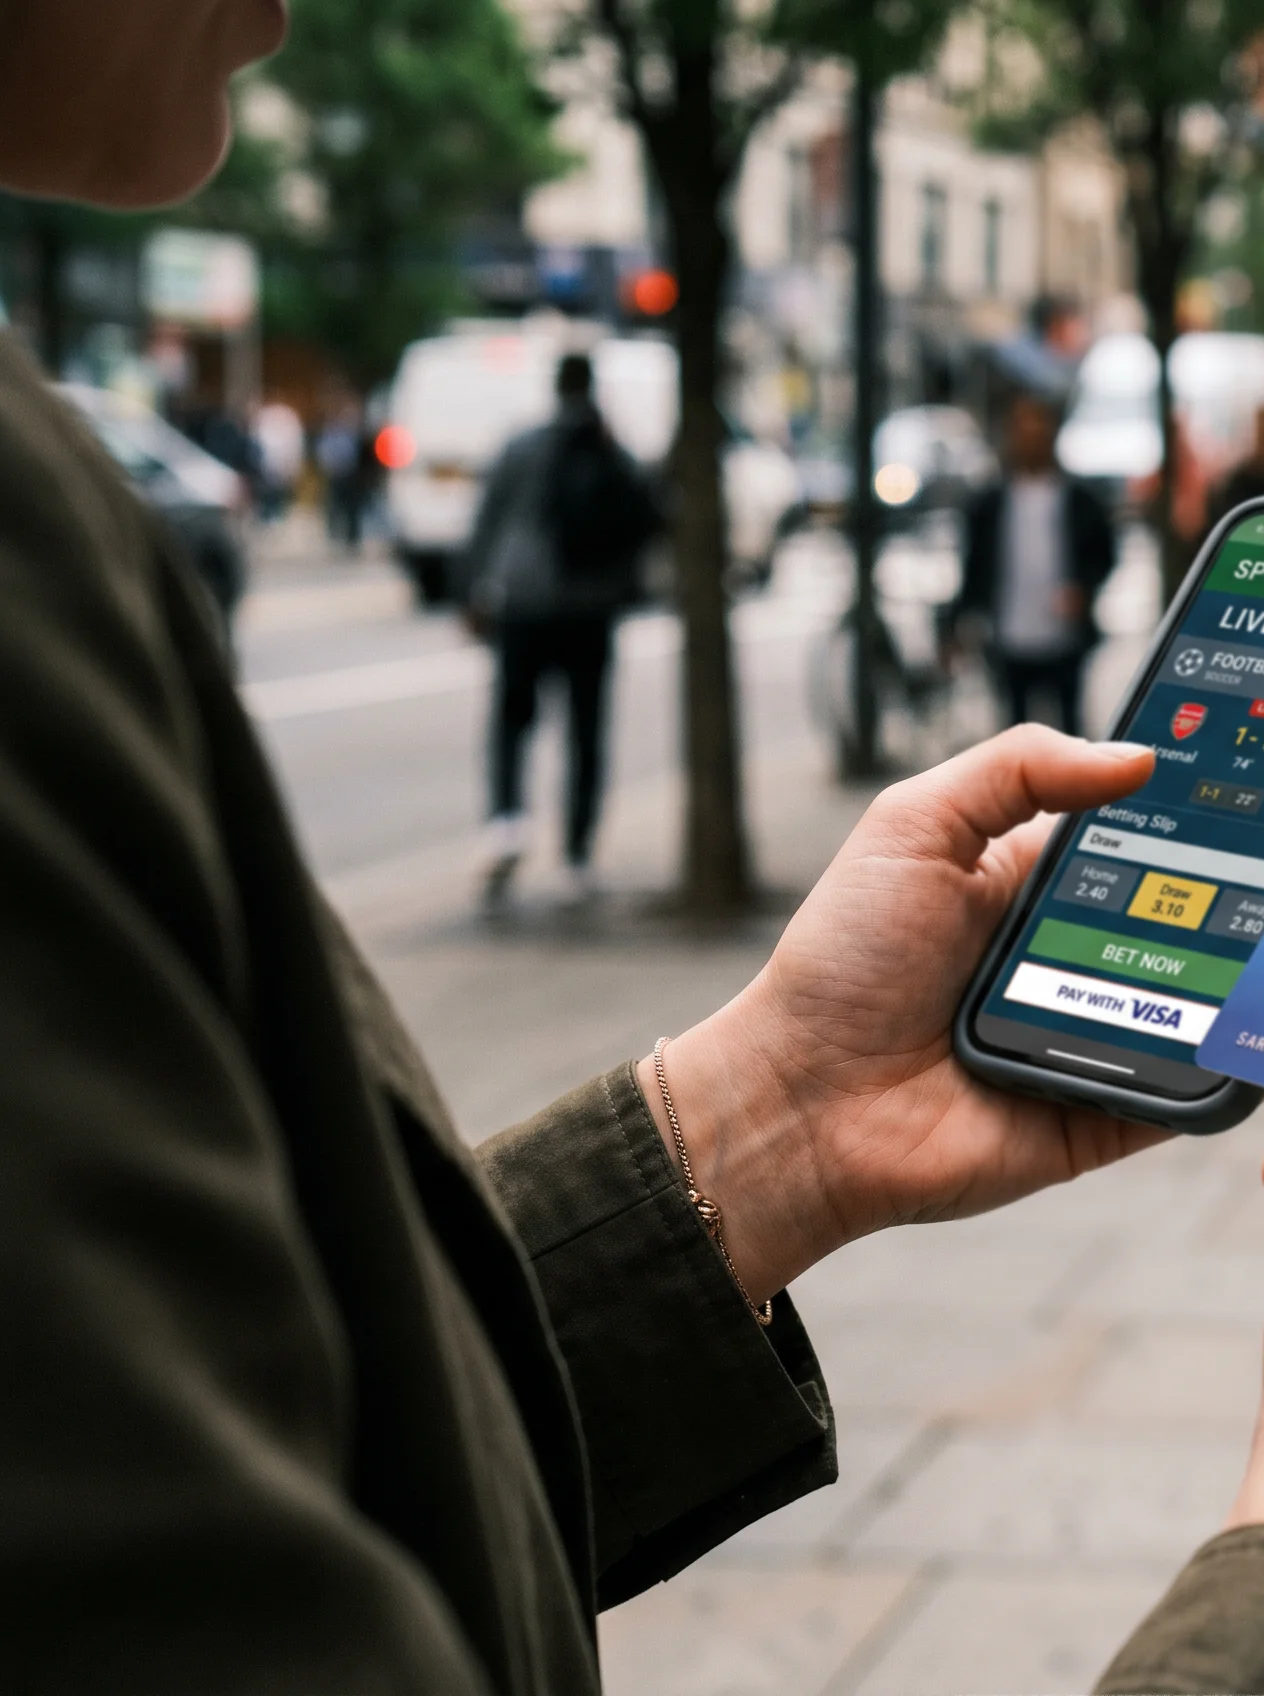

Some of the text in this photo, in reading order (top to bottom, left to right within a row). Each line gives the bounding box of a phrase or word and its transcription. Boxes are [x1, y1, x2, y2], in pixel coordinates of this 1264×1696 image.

[1097, 805, 1178, 834] Betting Slip
[1089, 833, 1122, 850] Draw
[1081, 865, 1119, 884] Home
[1075, 884, 1108, 900] 2.40
[1159, 883, 1192, 900] Draw
[1151, 901, 1184, 918] 3.10
[1229, 918, 1263, 935] 2.80
[1102, 944, 1186, 976] BET NOW
[1056, 985, 1184, 1030] PAY WITH VISA
